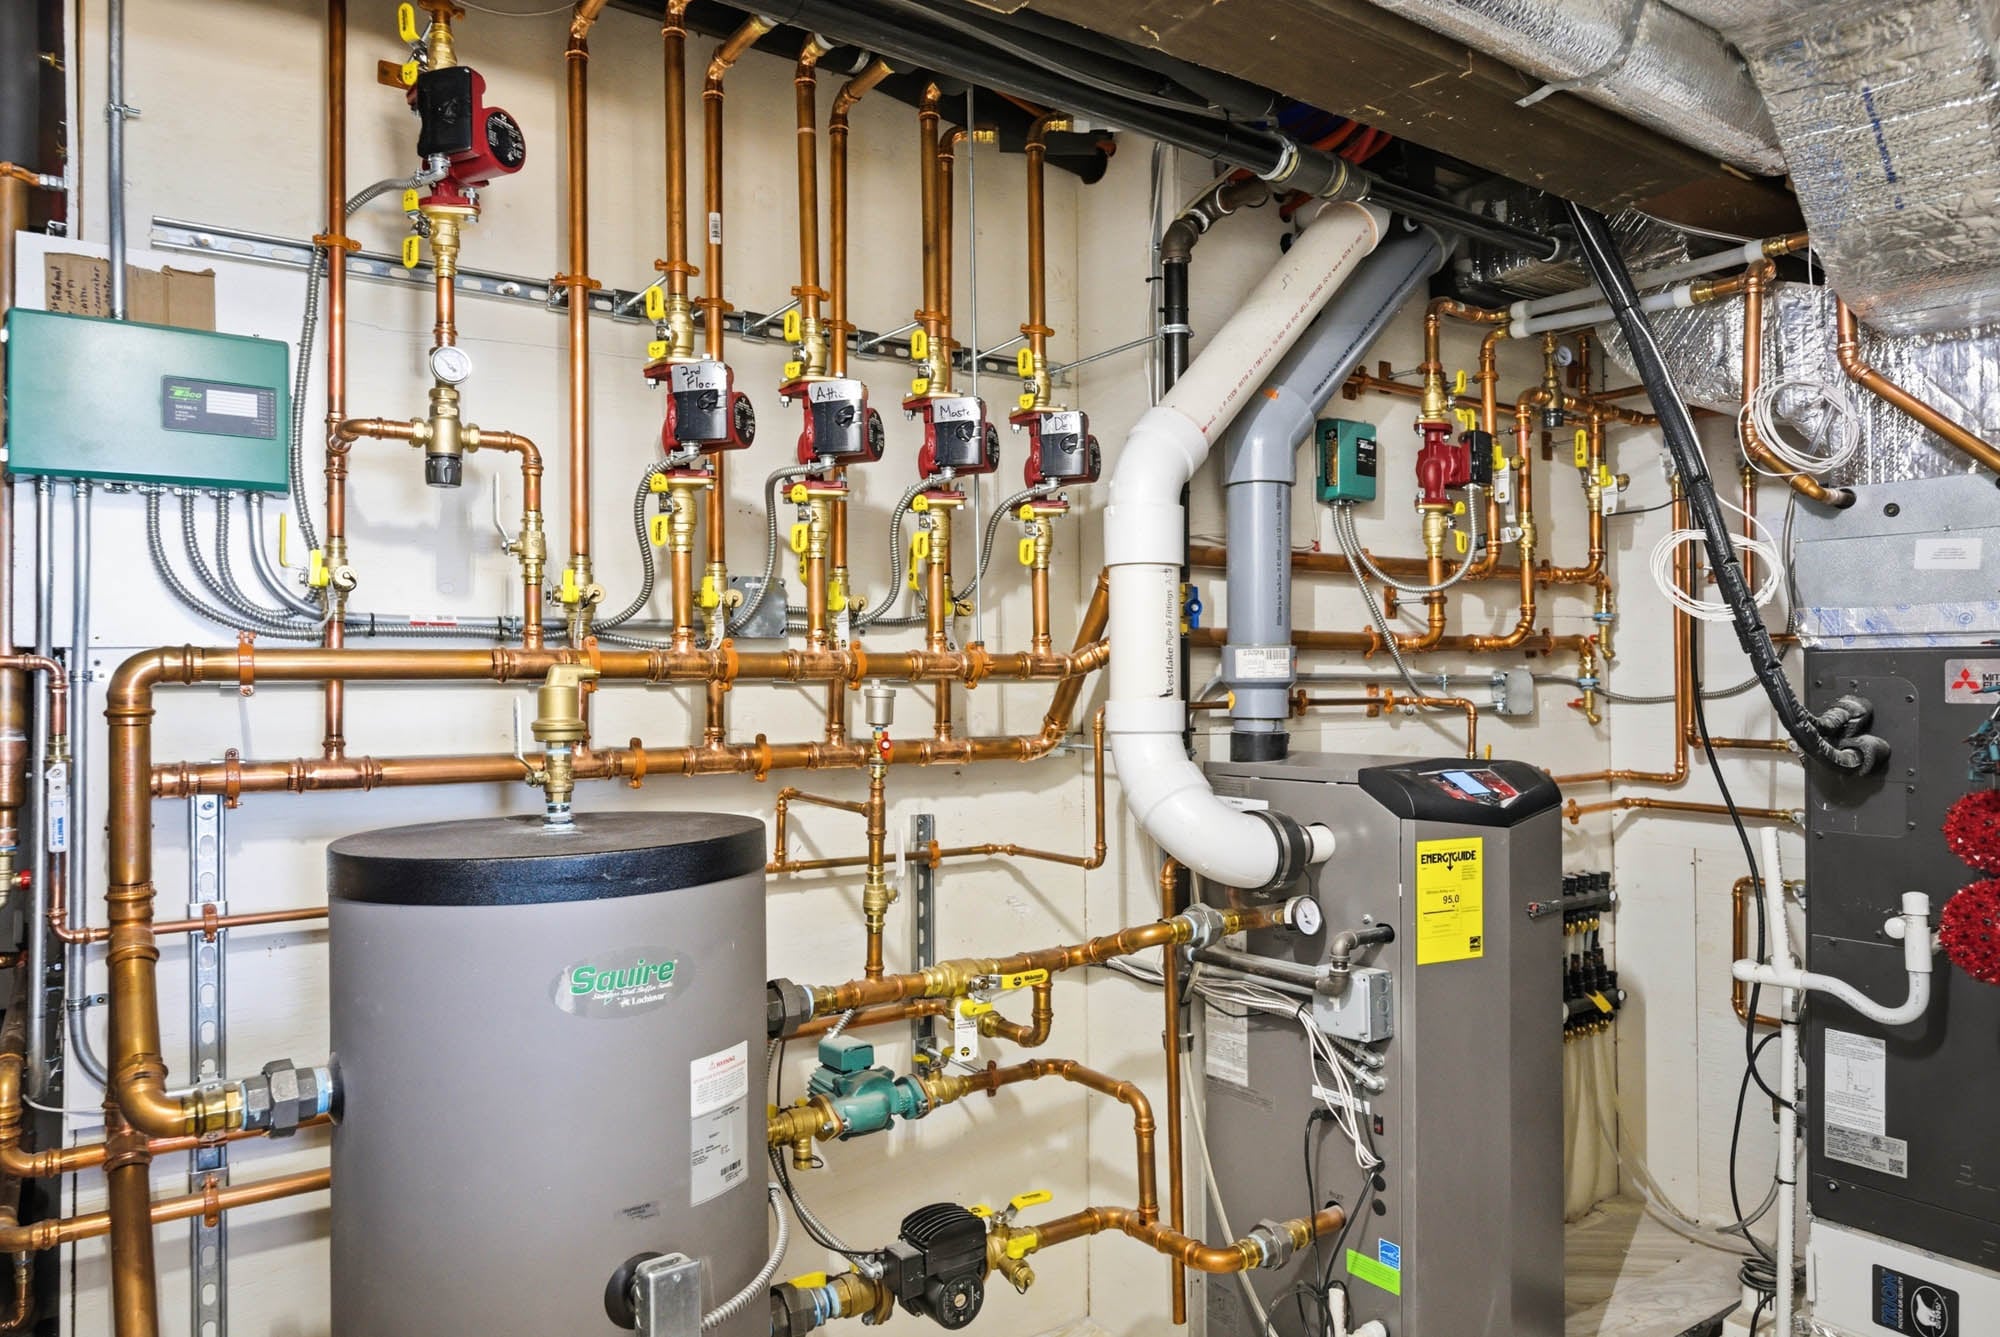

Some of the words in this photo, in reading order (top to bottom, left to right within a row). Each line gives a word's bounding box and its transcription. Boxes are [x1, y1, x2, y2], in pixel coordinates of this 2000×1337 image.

[680, 365, 701, 376] 2nd
[1165, 628, 1175, 646] Pipe
[1421, 850, 1477, 866] ENERGYGUIDE
[1442, 894, 1460, 905] 95.0
[570, 959, 675, 1005] Squire
